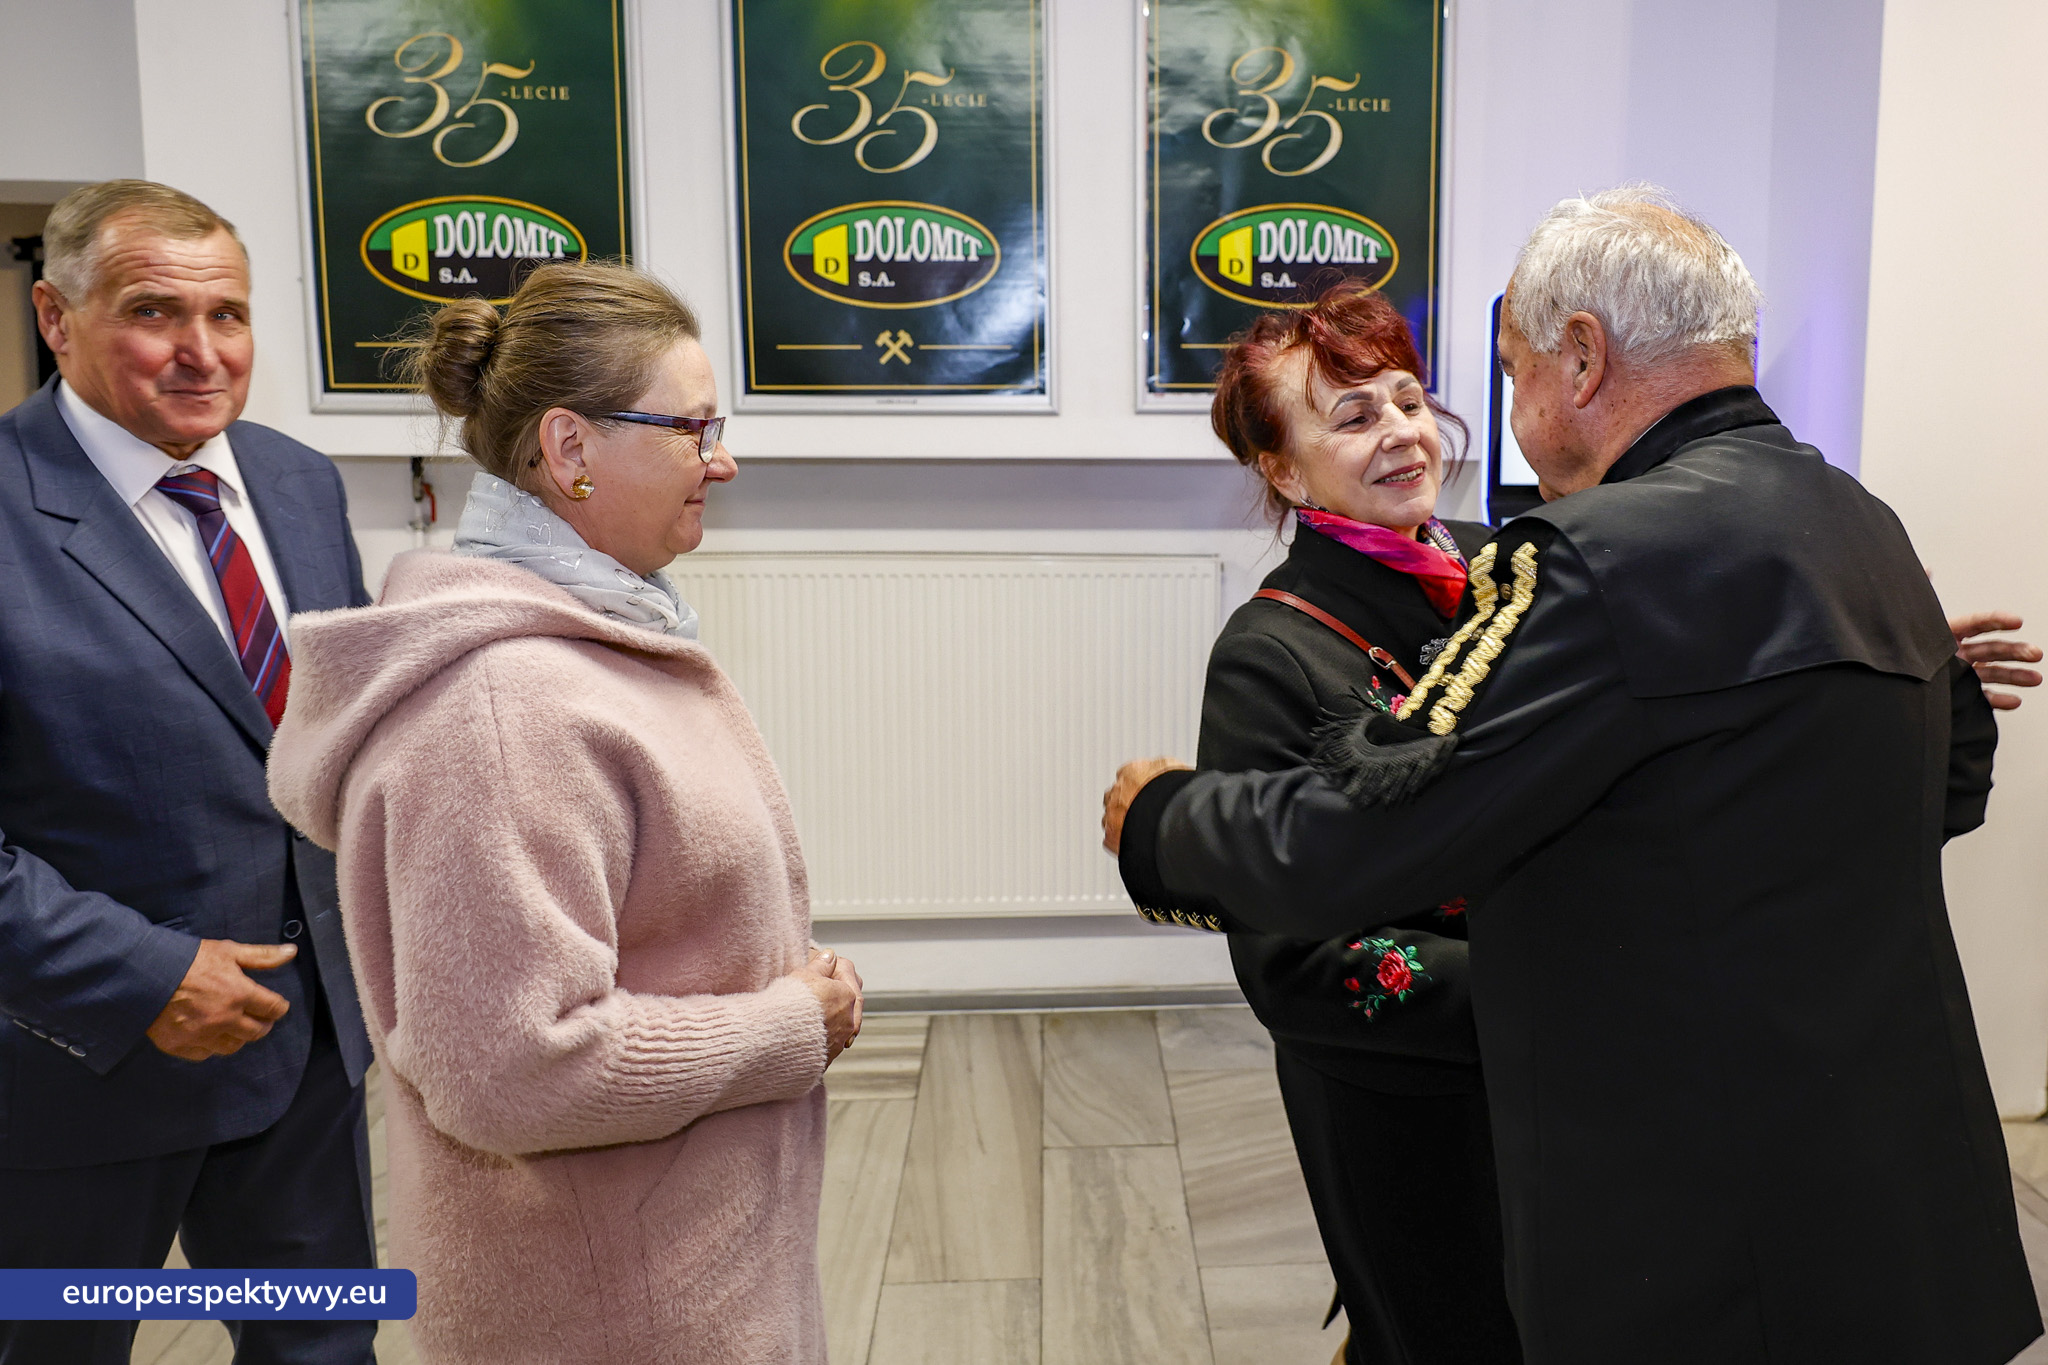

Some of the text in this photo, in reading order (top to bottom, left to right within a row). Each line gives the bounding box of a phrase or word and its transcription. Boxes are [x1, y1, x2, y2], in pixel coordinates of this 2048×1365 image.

[434, 211, 569, 260] DOLOMIT
[854, 215, 984, 263] DOLOMIT
[1257, 217, 1383, 265] DOLOMIT
[403, 252, 419, 271] D
[823, 257, 840, 275] D
[1228, 258, 1244, 276] D
[438, 268, 478, 284] S.A.
[858, 272, 896, 288] S.A.
[1260, 272, 1298, 289] S.A.
